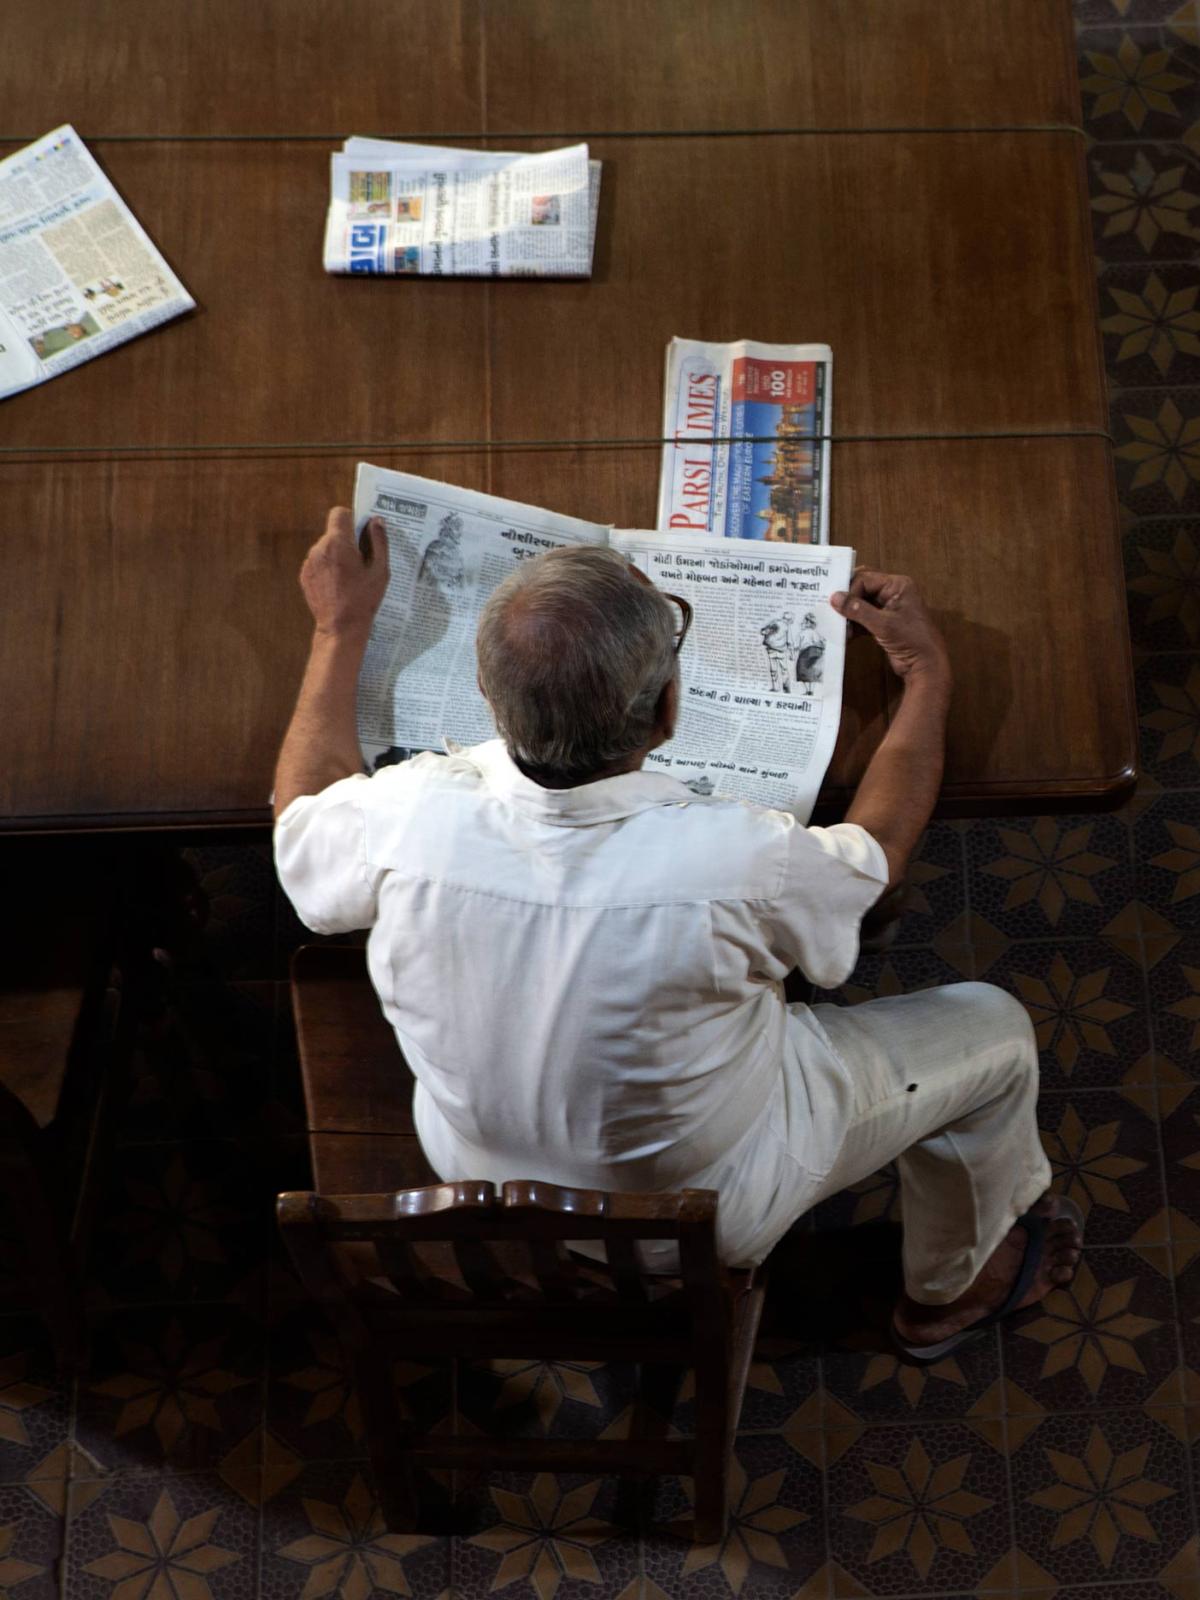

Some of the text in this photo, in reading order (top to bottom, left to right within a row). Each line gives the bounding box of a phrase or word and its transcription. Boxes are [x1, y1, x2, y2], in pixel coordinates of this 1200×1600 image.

[770, 370, 785, 397] 100
[669, 372, 716, 531] PARSI TIMES
[744, 432, 754, 464] EUROE
